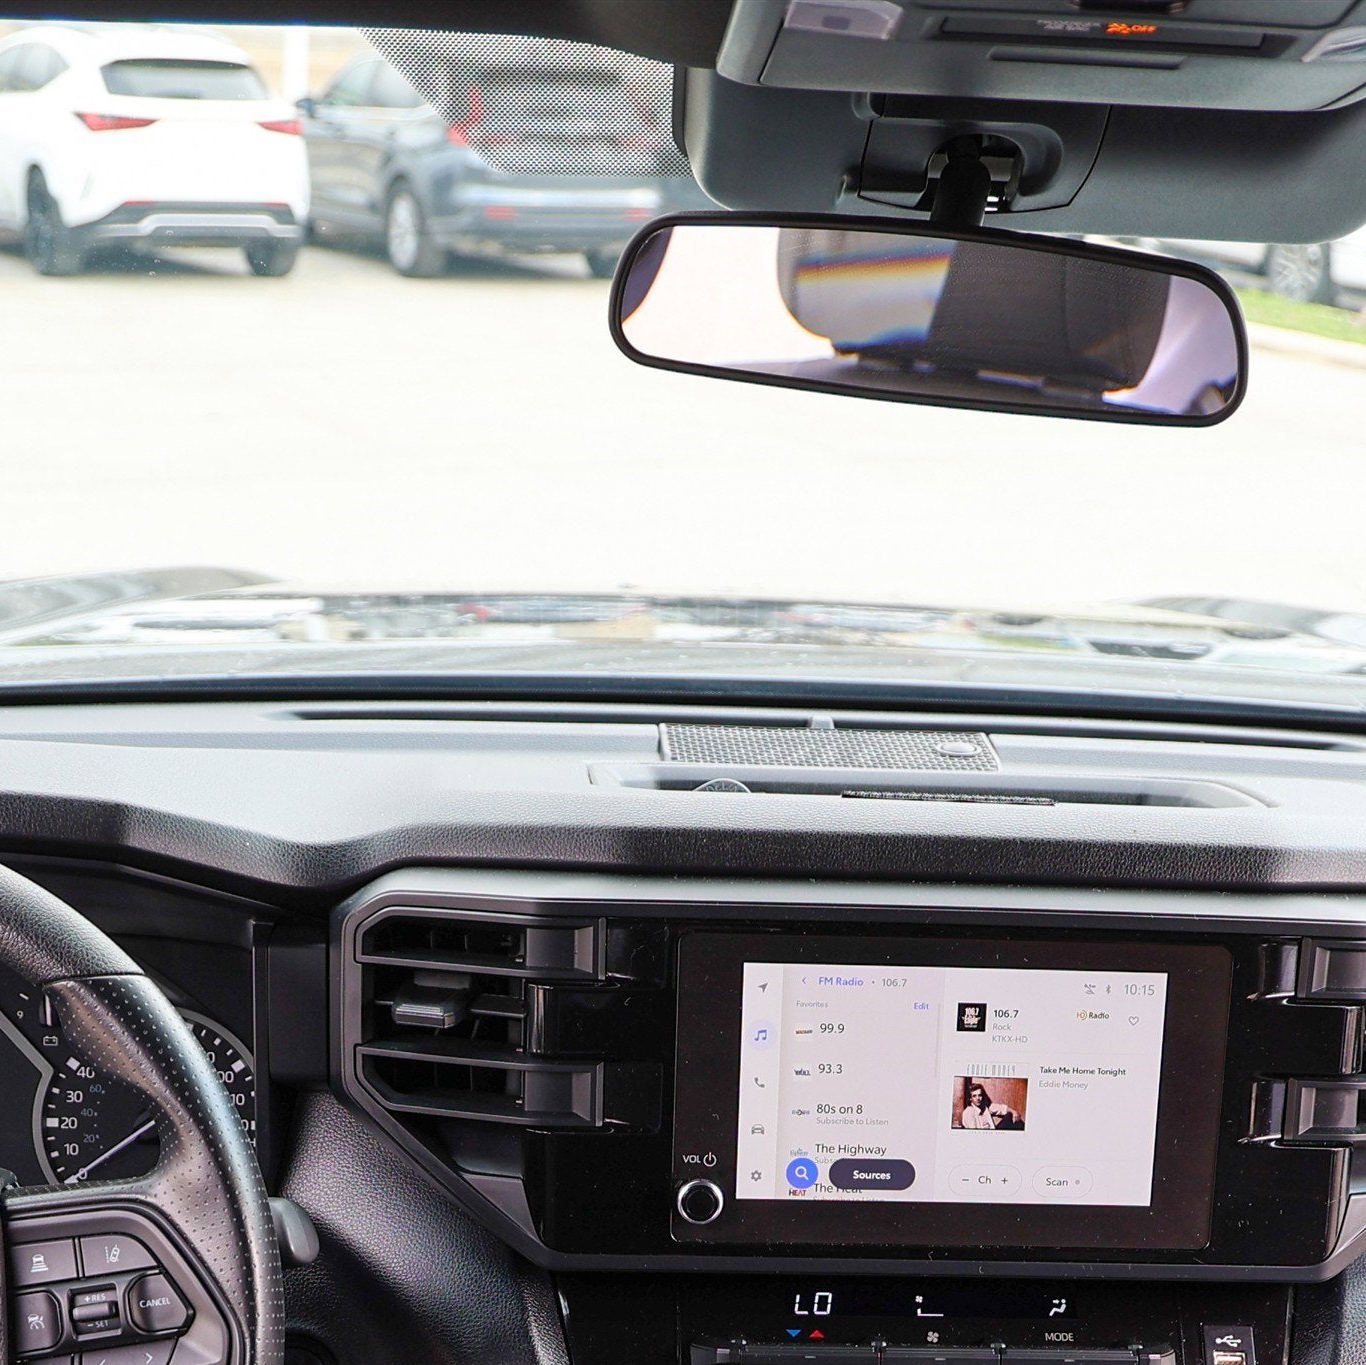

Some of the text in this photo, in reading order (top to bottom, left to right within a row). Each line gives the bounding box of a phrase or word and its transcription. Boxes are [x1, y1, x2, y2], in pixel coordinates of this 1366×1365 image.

[818, 976, 907, 988] FM Radio 106.7
[1124, 984, 1155, 996] 10:15
[796, 1000, 829, 1008] Favorites
[914, 1002, 929, 1011] Edit
[993, 1009, 1019, 1018] 106.7
[1089, 1011, 1110, 1020] Radio
[819, 1023, 845, 1034] 99.9
[993, 1023, 1011, 1031] Rock
[992, 1035, 1028, 1044] KTKX-HD
[76, 1066, 95, 1079] 40
[818, 1064, 843, 1074] 93.3
[1039, 1066, 1126, 1078] Take Me Home Tonight
[89, 1084, 102, 1093] 60
[1039, 1080, 1089, 1090] Eddie Money
[65, 1090, 83, 1103] 30
[817, 1104, 836, 1114] 80s
[839, 1106, 853, 1114] on
[856, 1104, 863, 1114] 8
[61, 1117, 77, 1130] 20
[816, 1116, 889, 1126] Subscribe to Listen
[64, 1143, 79, 1156] 10
[815, 1144, 835, 1154] The
[838, 1144, 887, 1156] Highway
[682, 1154, 701, 1164] VOL
[853, 1170, 891, 1180] Sources
[978, 1175, 992, 1184] Ch
[1045, 1177, 1069, 1187] Scan
[815, 1183, 833, 1194] The
[139, 1297, 171, 1308] CANCEL
[794, 1292, 833, 1316] LO
[1045, 1332, 1075, 1342] MODE
